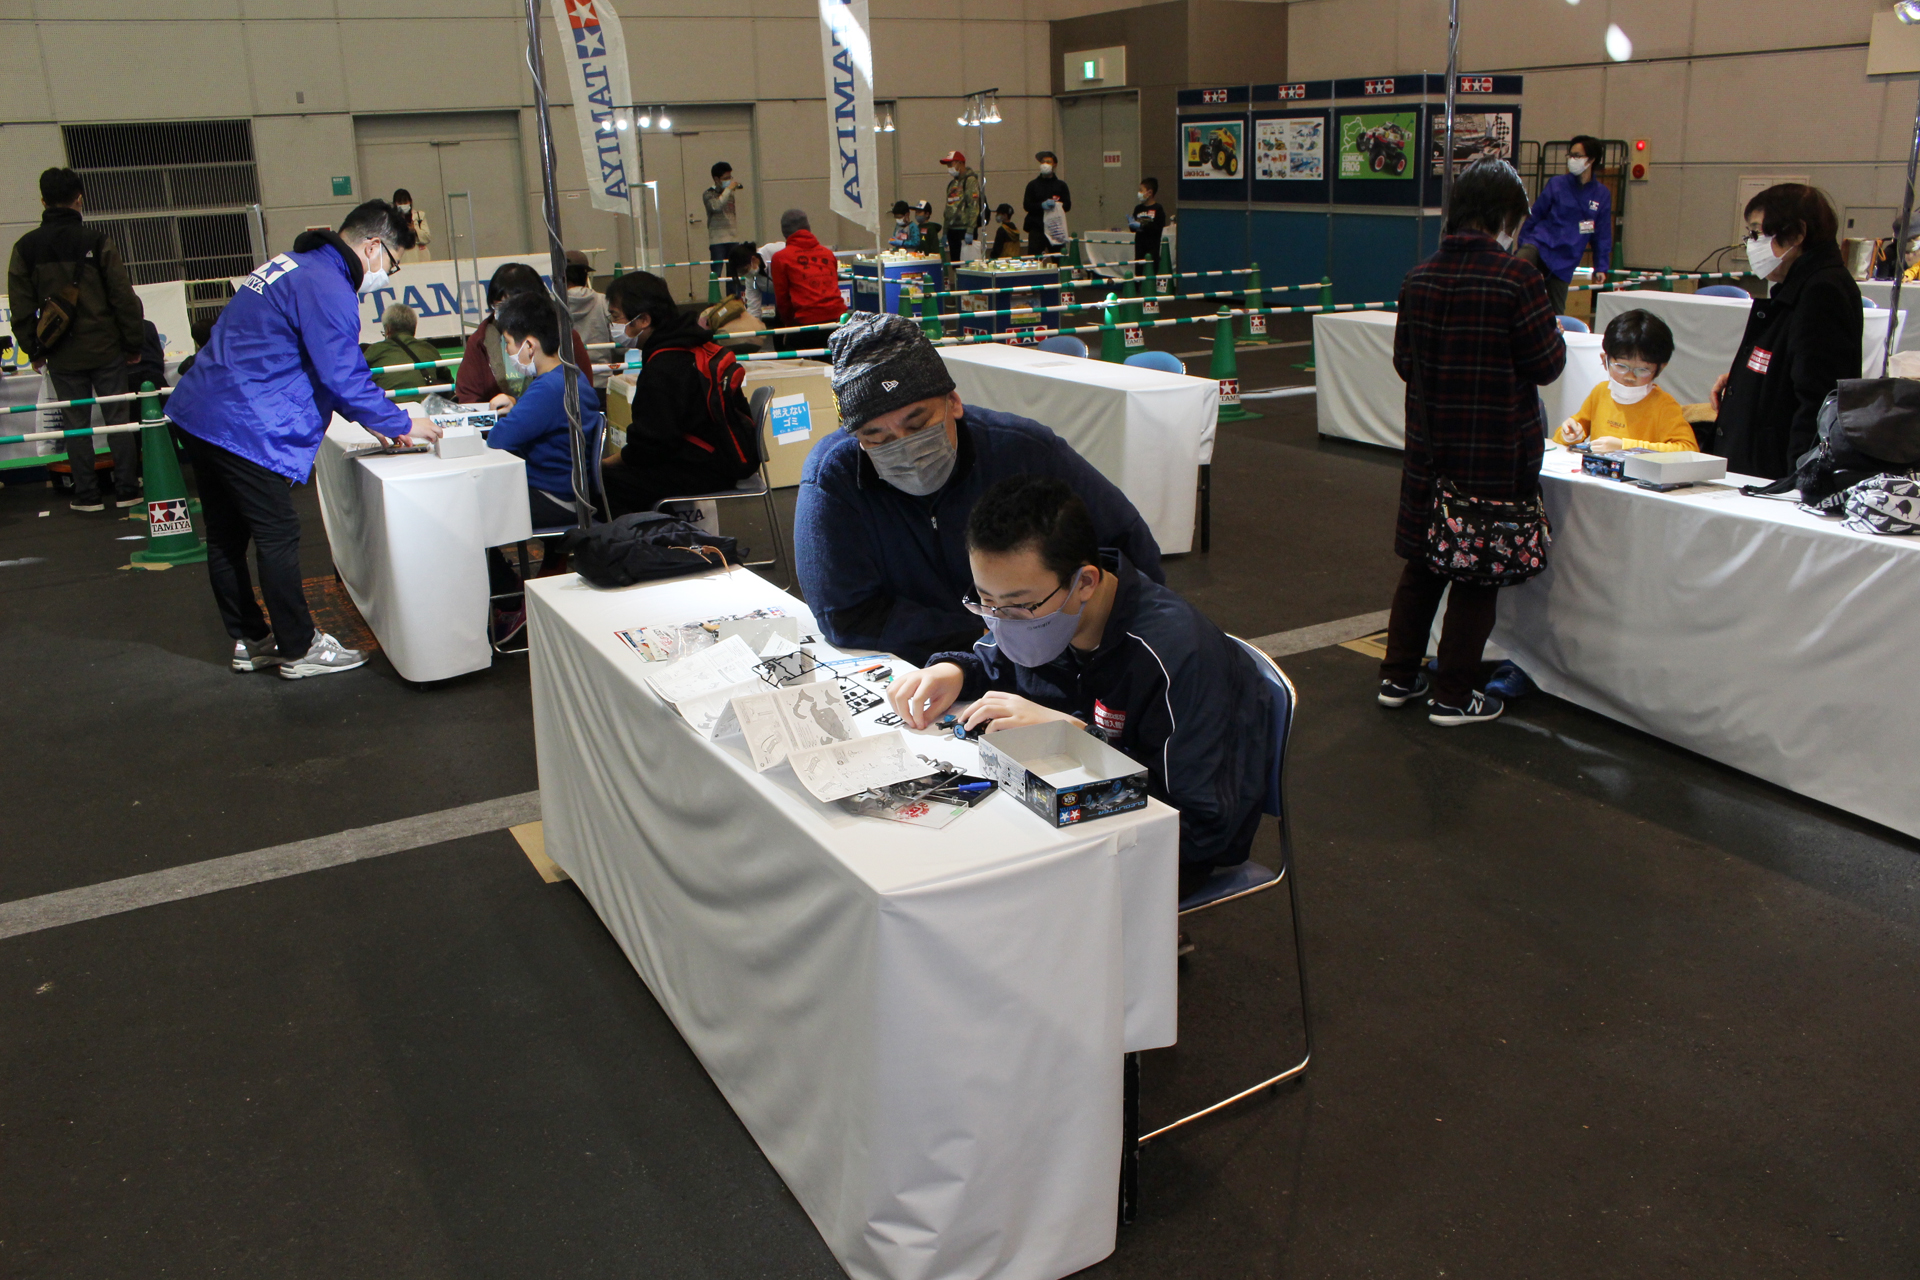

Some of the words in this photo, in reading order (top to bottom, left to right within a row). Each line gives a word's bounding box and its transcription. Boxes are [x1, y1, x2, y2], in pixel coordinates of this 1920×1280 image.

[772, 405, 807, 419] 燃えない
[783, 417, 799, 427] ゴミ
[152, 520, 191, 532] TAMIYA
[320, 650, 337, 662] N
[1467, 698, 1483, 714] N
